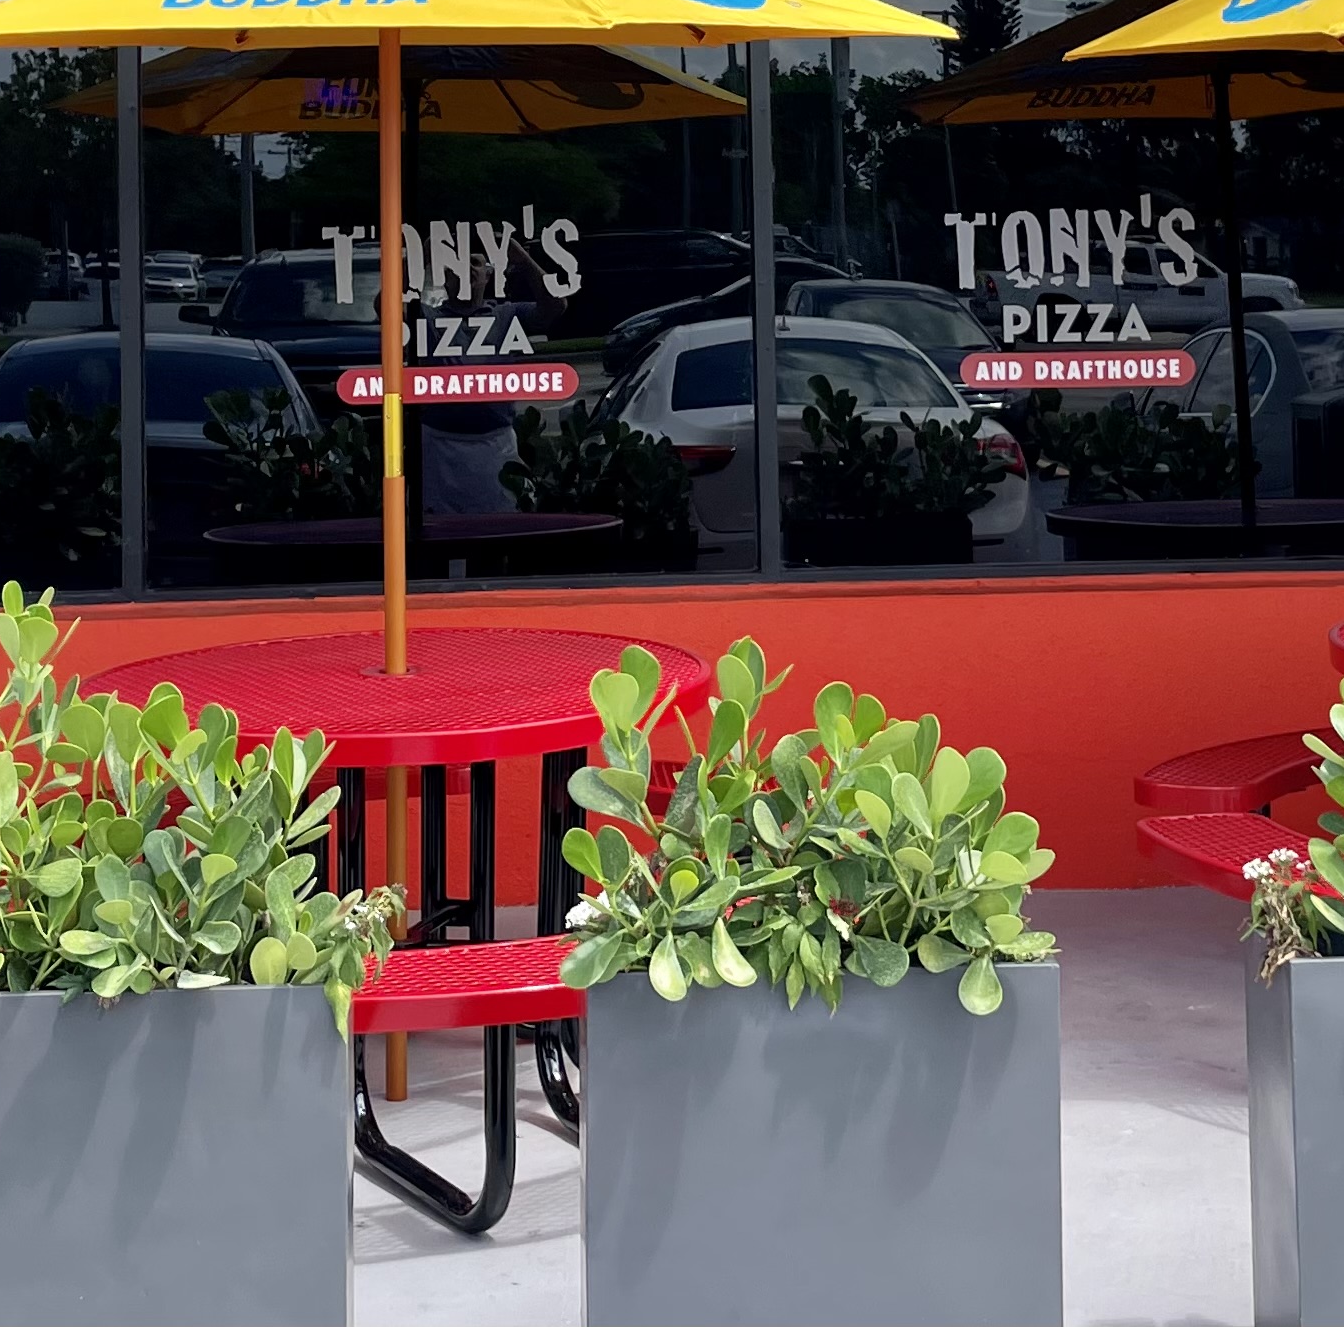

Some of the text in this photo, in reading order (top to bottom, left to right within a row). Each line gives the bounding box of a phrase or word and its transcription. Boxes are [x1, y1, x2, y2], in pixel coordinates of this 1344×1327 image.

[299, 99, 442, 120] BUDA
[1027, 85, 1156, 109] BUDDHA
[322, 204, 582, 304] TONY'S
[944, 193, 1199, 290] TONY'S
[402, 316, 534, 358] IZZA
[1003, 302, 1152, 343] PIZZA
[352, 371, 563, 397] AN DRAFTHOUSE
[975, 358, 1180, 381] AND DRAFTHOUSE
